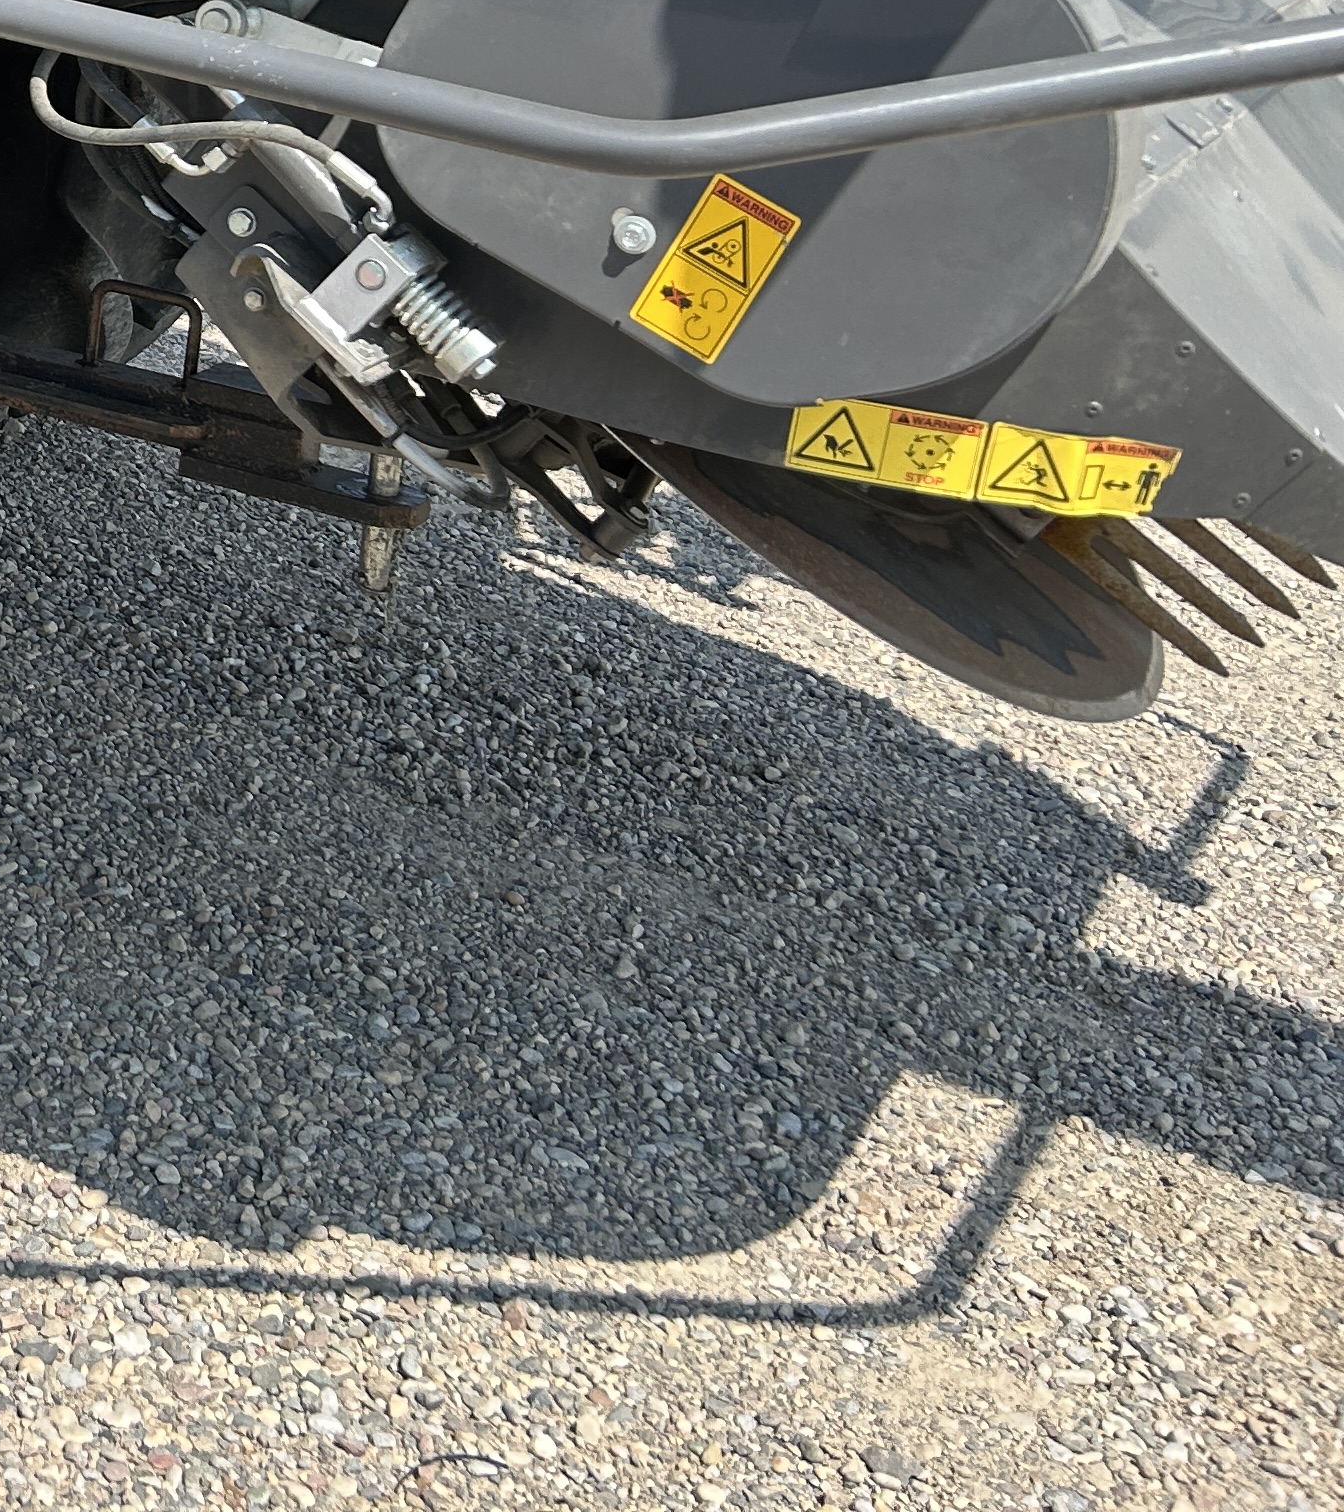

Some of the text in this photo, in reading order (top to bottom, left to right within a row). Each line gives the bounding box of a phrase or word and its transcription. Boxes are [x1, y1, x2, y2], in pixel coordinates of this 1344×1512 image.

[731, 191, 790, 231] WARNING
[911, 415, 977, 434] WARNING
[1107, 444, 1171, 459] WARNING
[904, 471, 945, 486] STOP
